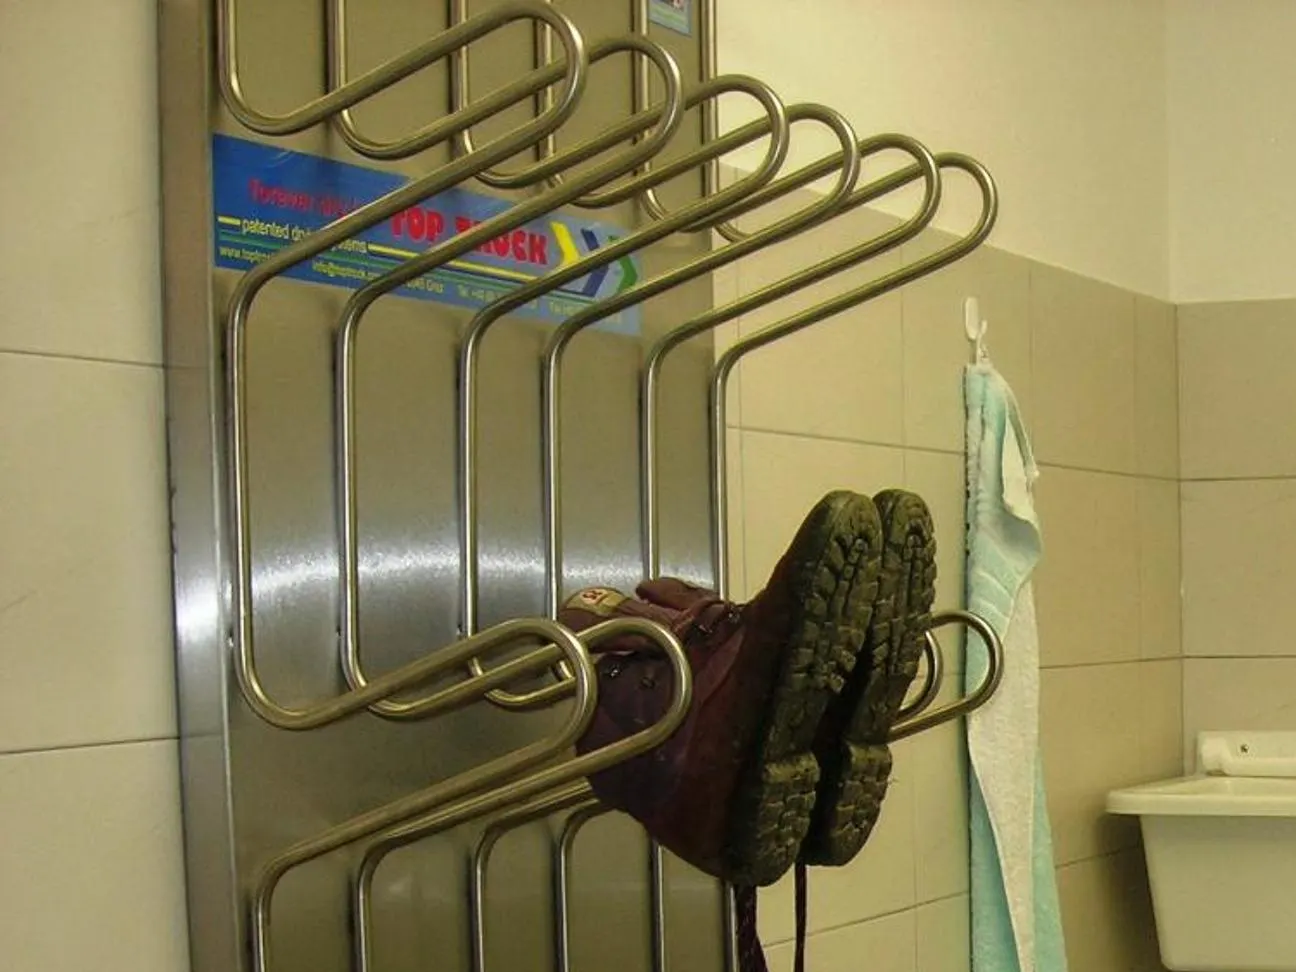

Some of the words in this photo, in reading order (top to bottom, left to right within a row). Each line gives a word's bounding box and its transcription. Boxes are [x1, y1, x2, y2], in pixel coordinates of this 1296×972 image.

[242, 217, 290, 240] patented
[391, 206, 444, 241] TOP
[456, 215, 549, 265] TOCK
